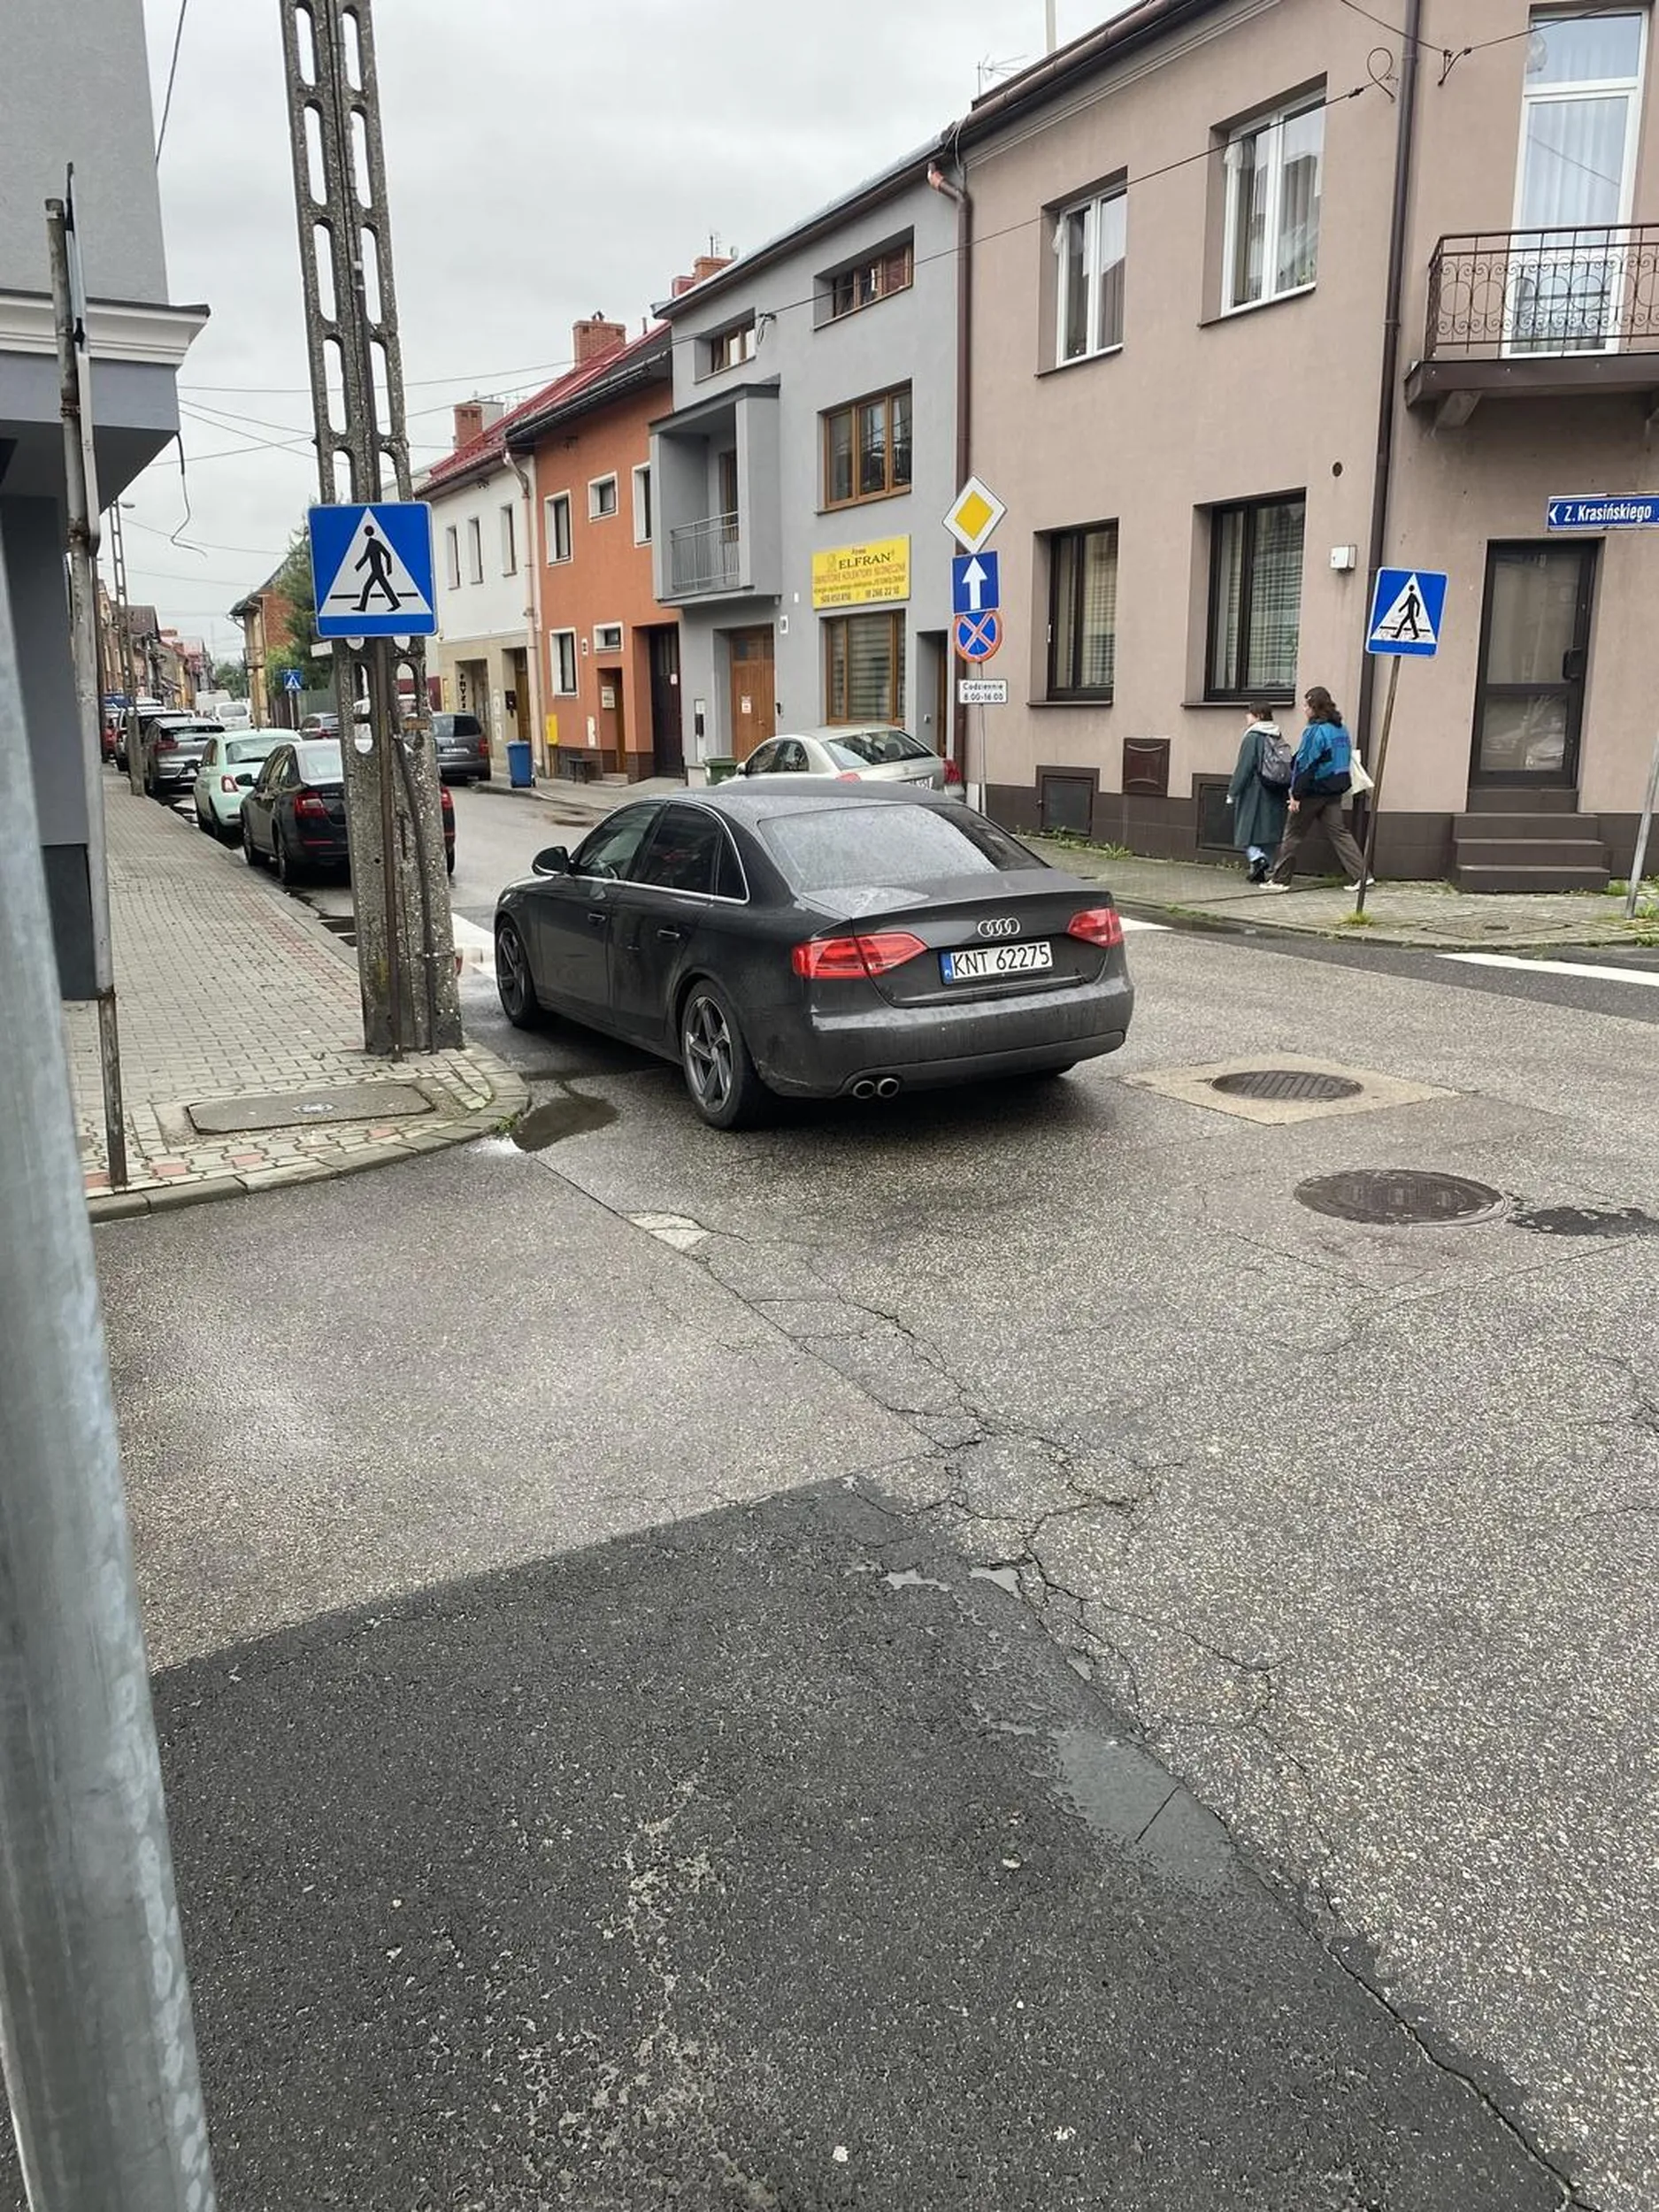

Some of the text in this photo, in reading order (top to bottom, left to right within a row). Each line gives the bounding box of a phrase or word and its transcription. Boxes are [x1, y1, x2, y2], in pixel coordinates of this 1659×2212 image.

[1578, 502, 1652, 523] Krasińskiego
[839, 552, 890, 570] ELFRAN
[953, 944, 1050, 976] KNT 62275
